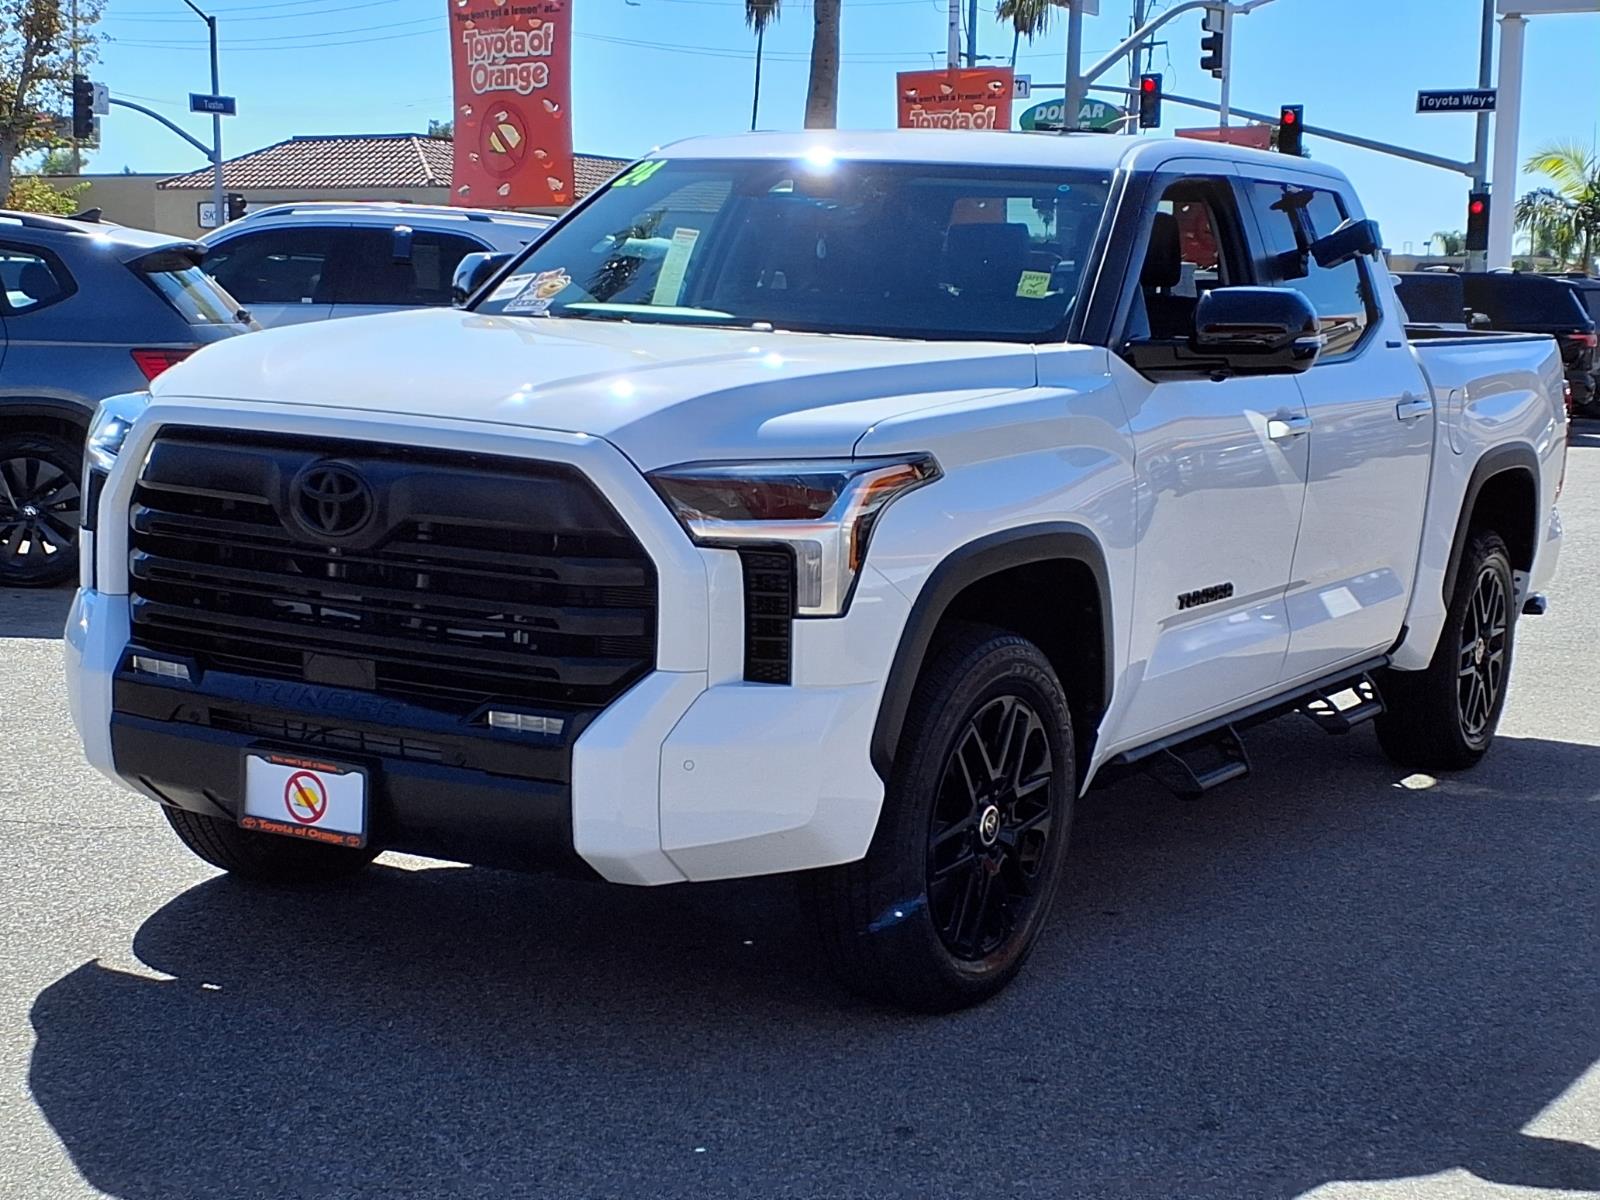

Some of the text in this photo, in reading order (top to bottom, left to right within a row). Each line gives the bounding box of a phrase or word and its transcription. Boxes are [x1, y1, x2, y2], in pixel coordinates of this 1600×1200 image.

[463, 22, 554, 65] Toyota of
[470, 61, 549, 95] Orange
[1420, 94, 1487, 108] Toyota Way
[909, 106, 996, 129] Toyota of
[611, 159, 668, 188] 24
[1177, 581, 1234, 611] TUNDRA
[258, 819, 344, 844] Toyota of Orange
